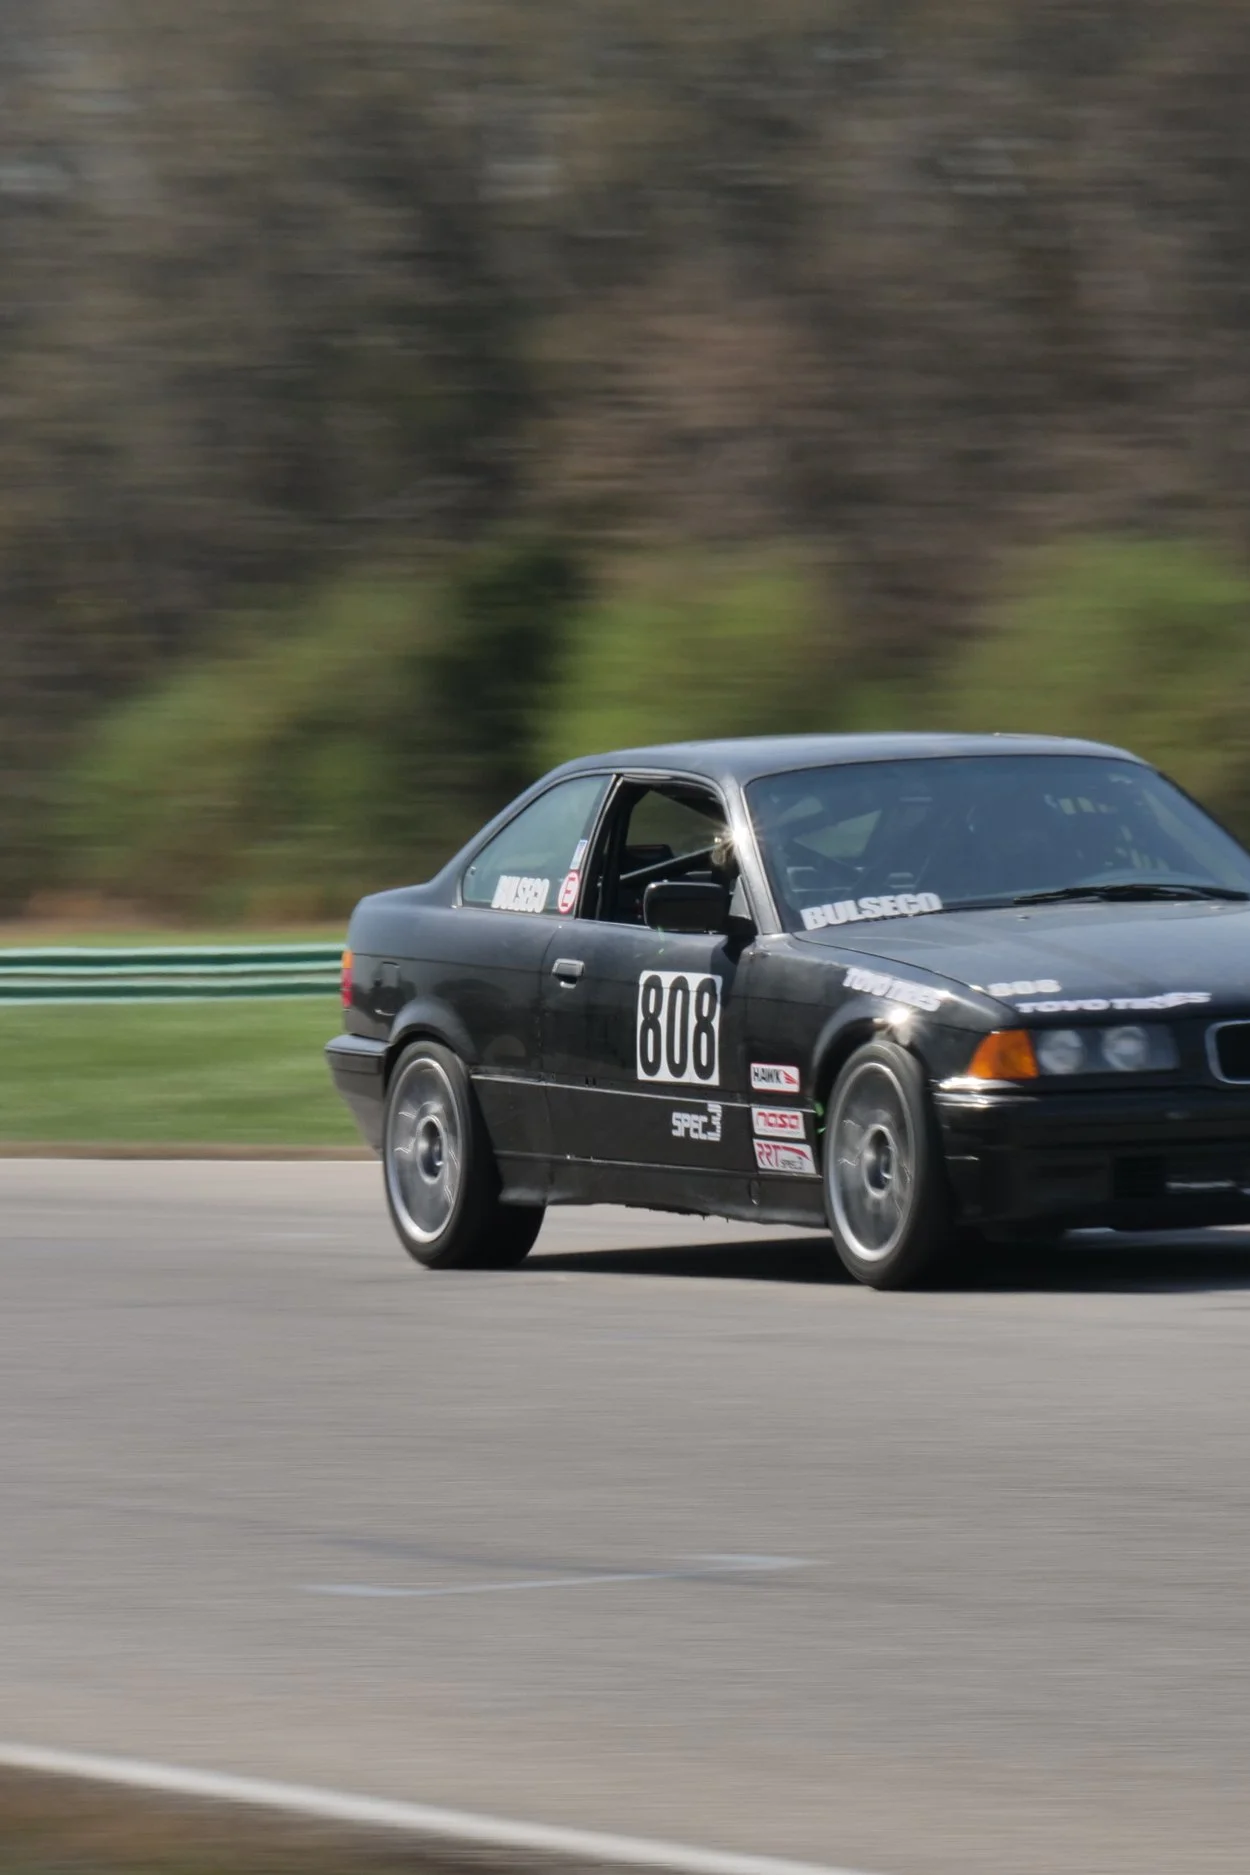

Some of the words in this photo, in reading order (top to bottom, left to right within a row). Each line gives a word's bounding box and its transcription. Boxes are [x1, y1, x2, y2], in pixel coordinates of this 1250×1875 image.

[1015, 998, 1109, 1014] TOYO
[639, 974, 718, 1081] 808
[752, 1066, 783, 1084] HAWK
